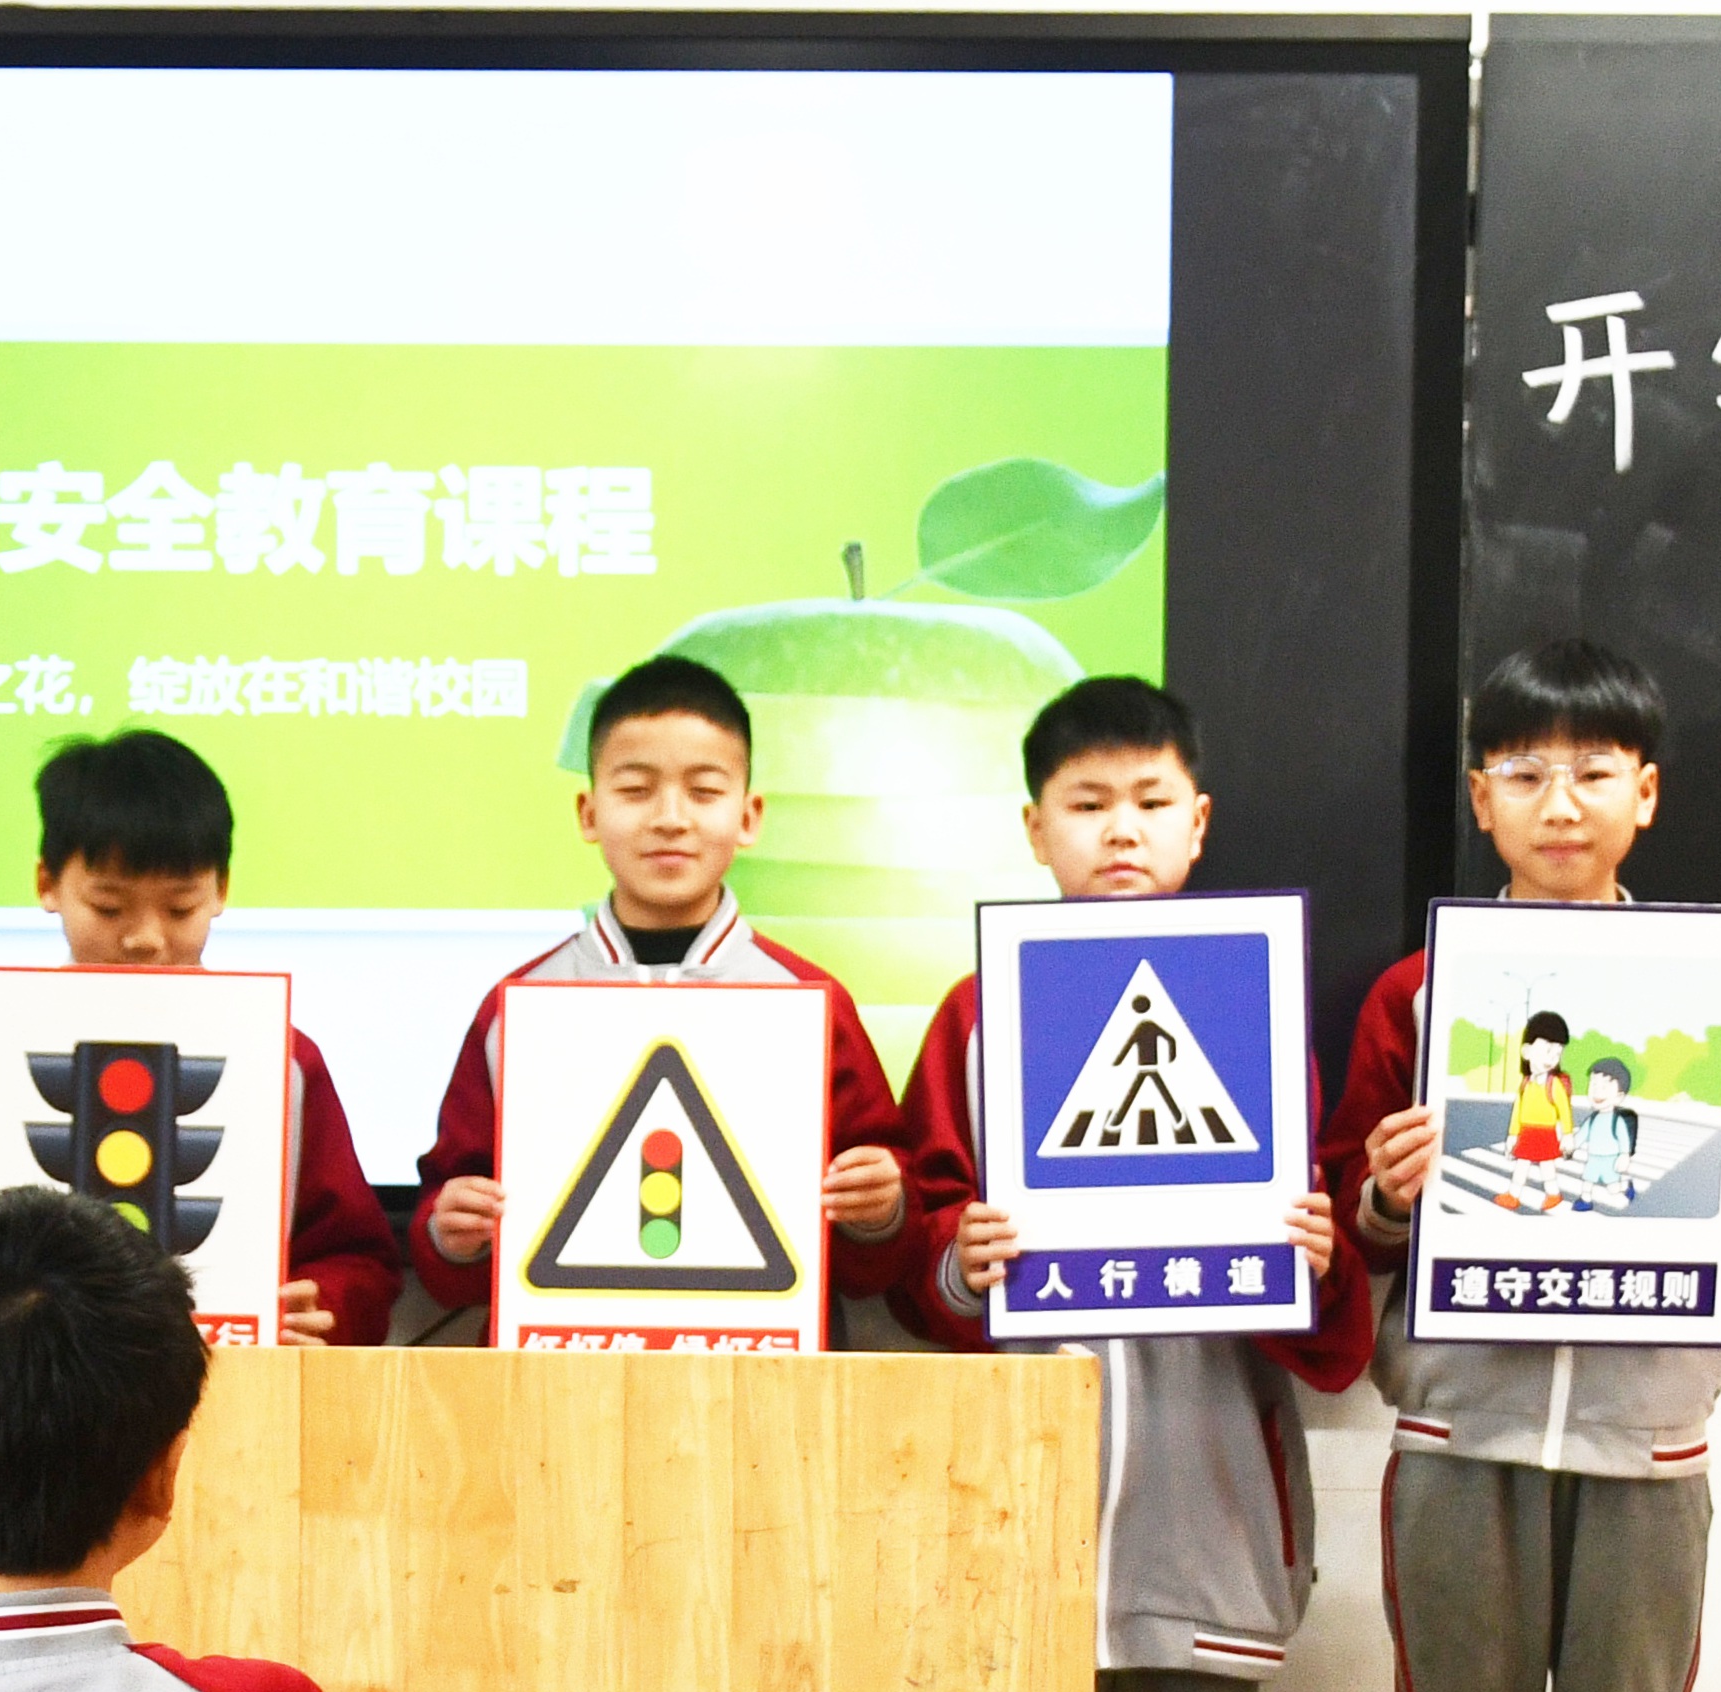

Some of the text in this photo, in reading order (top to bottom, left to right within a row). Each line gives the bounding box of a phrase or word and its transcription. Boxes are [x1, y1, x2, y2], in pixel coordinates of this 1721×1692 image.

[1035, 1255, 1266, 1299] 人行横道
[1450, 1265, 1699, 1308] 遵守交通规则
